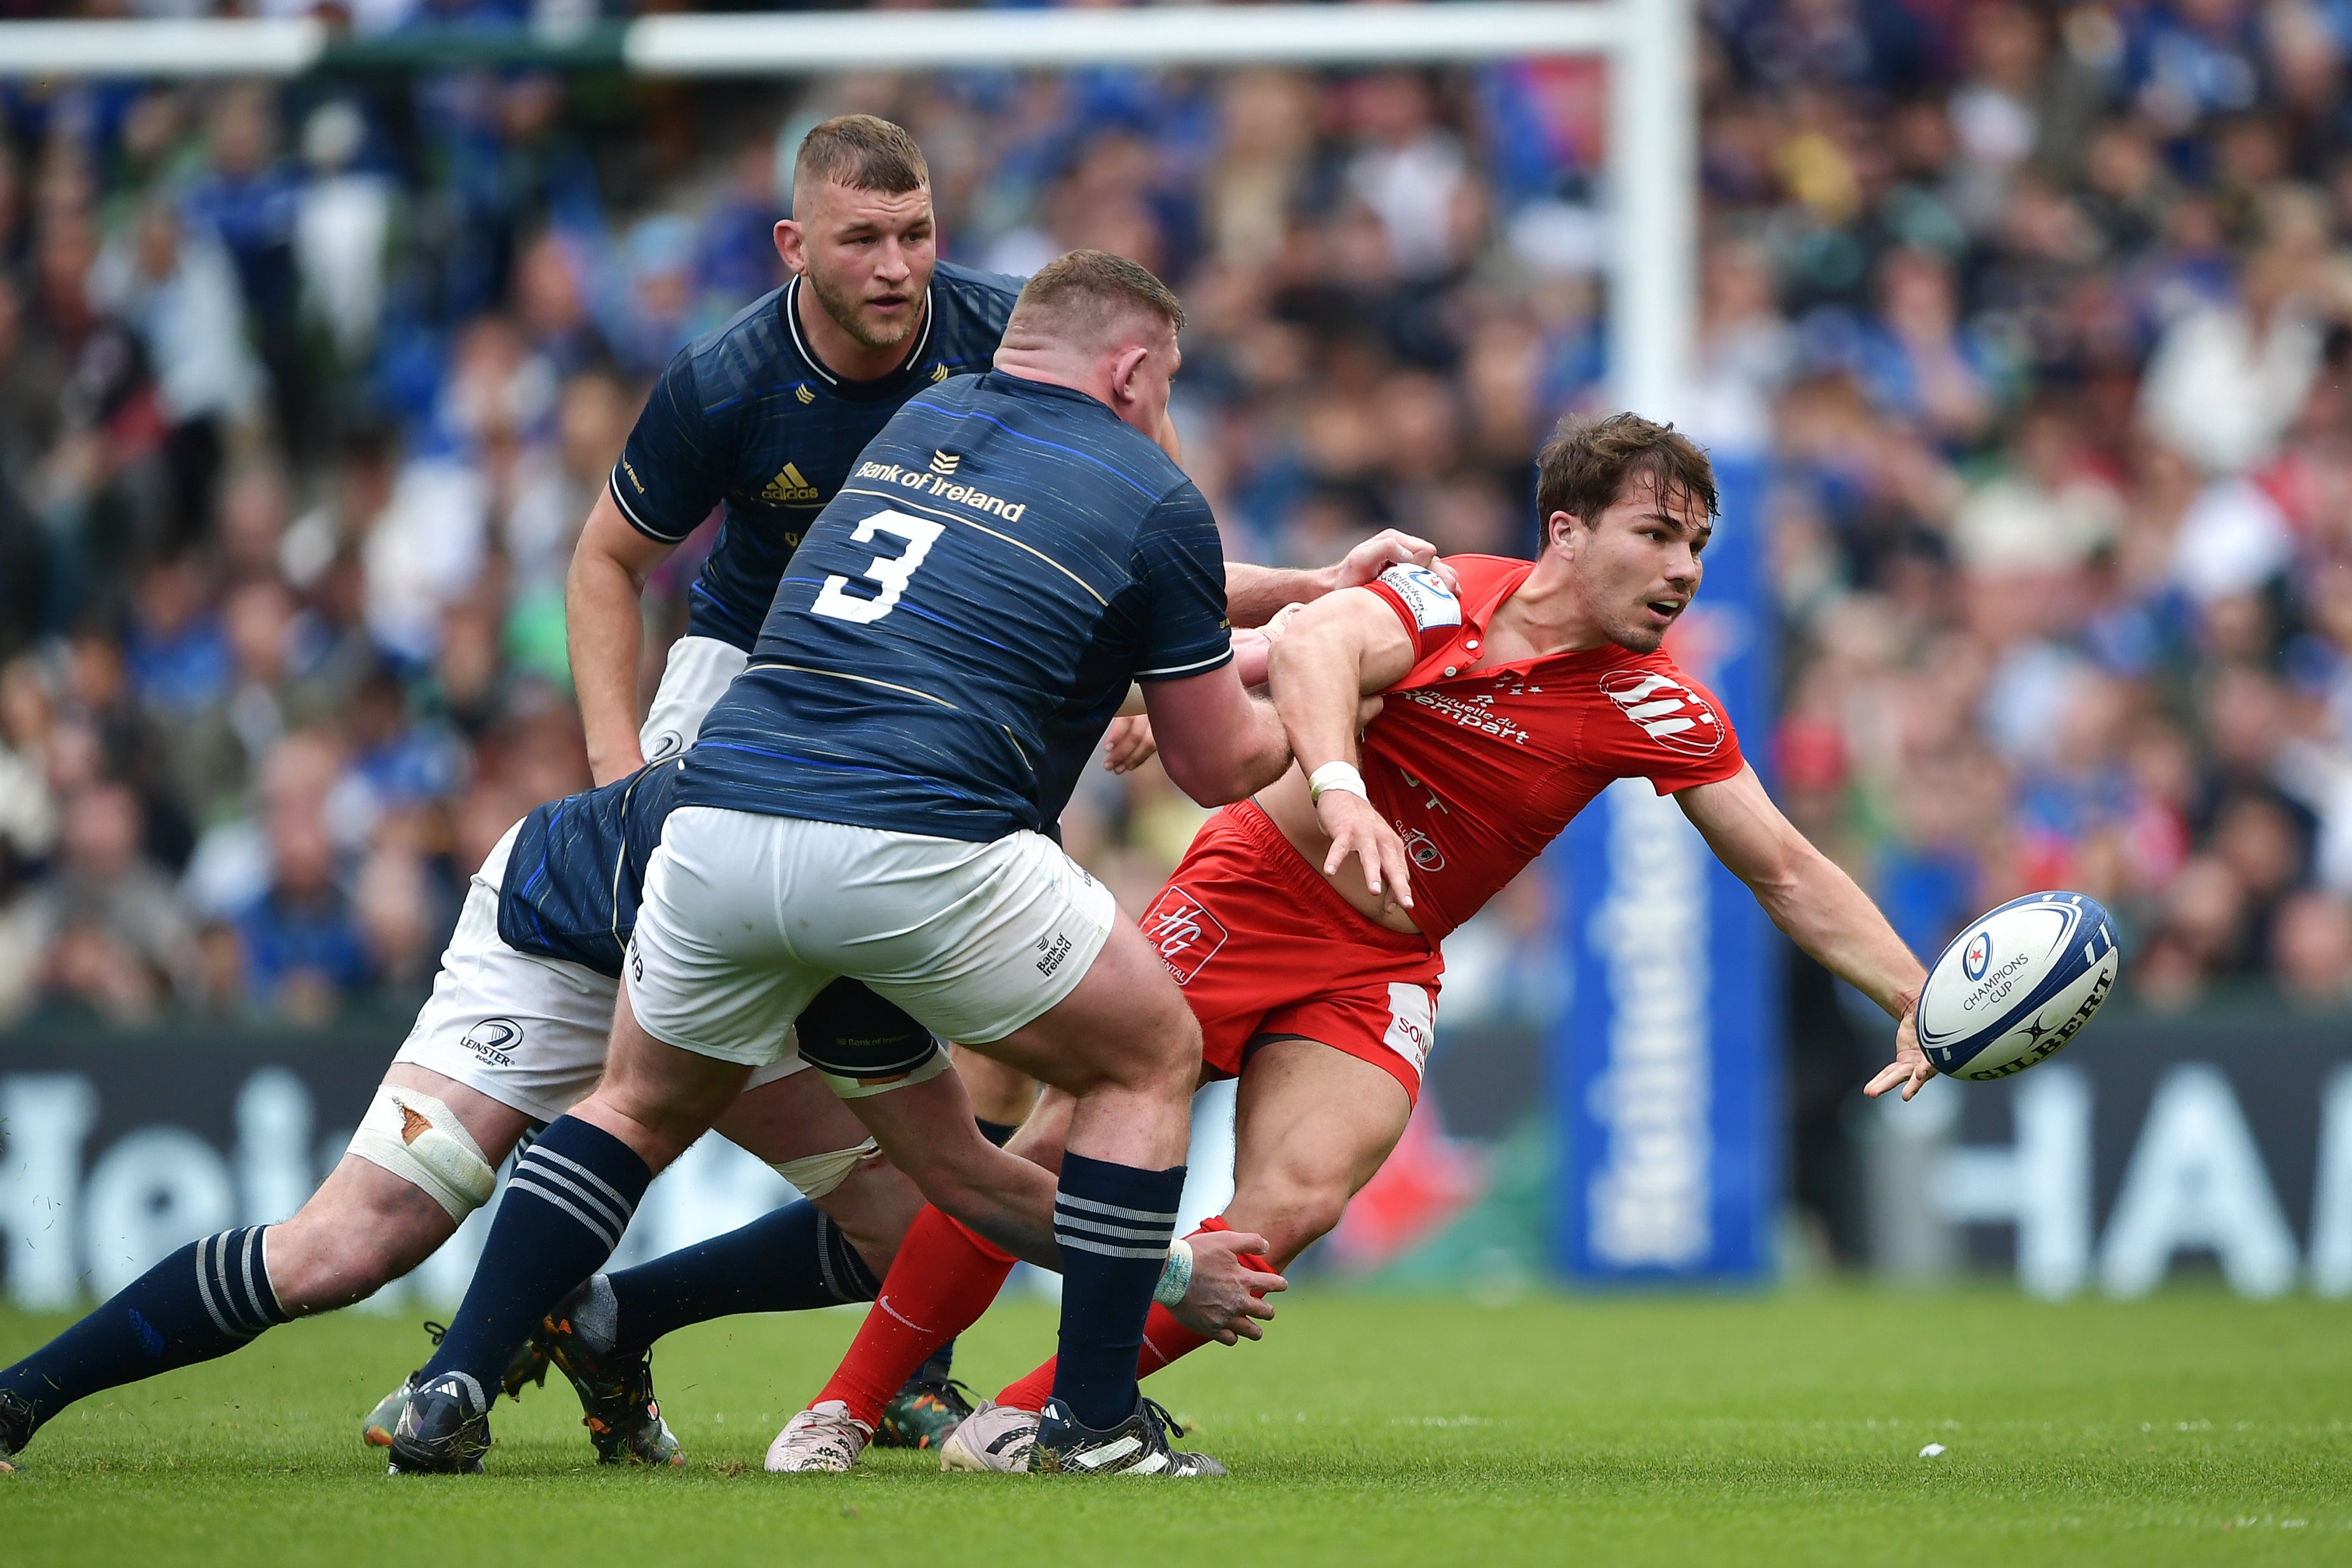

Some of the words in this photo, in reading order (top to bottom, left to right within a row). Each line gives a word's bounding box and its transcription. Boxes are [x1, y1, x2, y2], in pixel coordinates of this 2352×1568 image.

[761, 487, 819, 501] adidas
[854, 461, 900, 483] Bank
[901, 471, 930, 491] of
[928, 476, 1027, 522] Ireland
[809, 509, 947, 625] 3
[1424, 690, 1494, 720] mutuelle
[1495, 717, 1518, 729] du
[1395, 819, 1411, 842] CLUB
[1036, 943, 1059, 971] Bank
[1056, 931, 1066, 947] of
[1043, 939, 1072, 977] Ireland
[1963, 953, 2029, 1011] CHAMPIONS
[1989, 980, 2013, 1004] CUP
[1969, 966, 2113, 1081] GILBERT
[459, 1036, 511, 1067] LEINSTER
[475, 1054, 496, 1067] RUGBY
